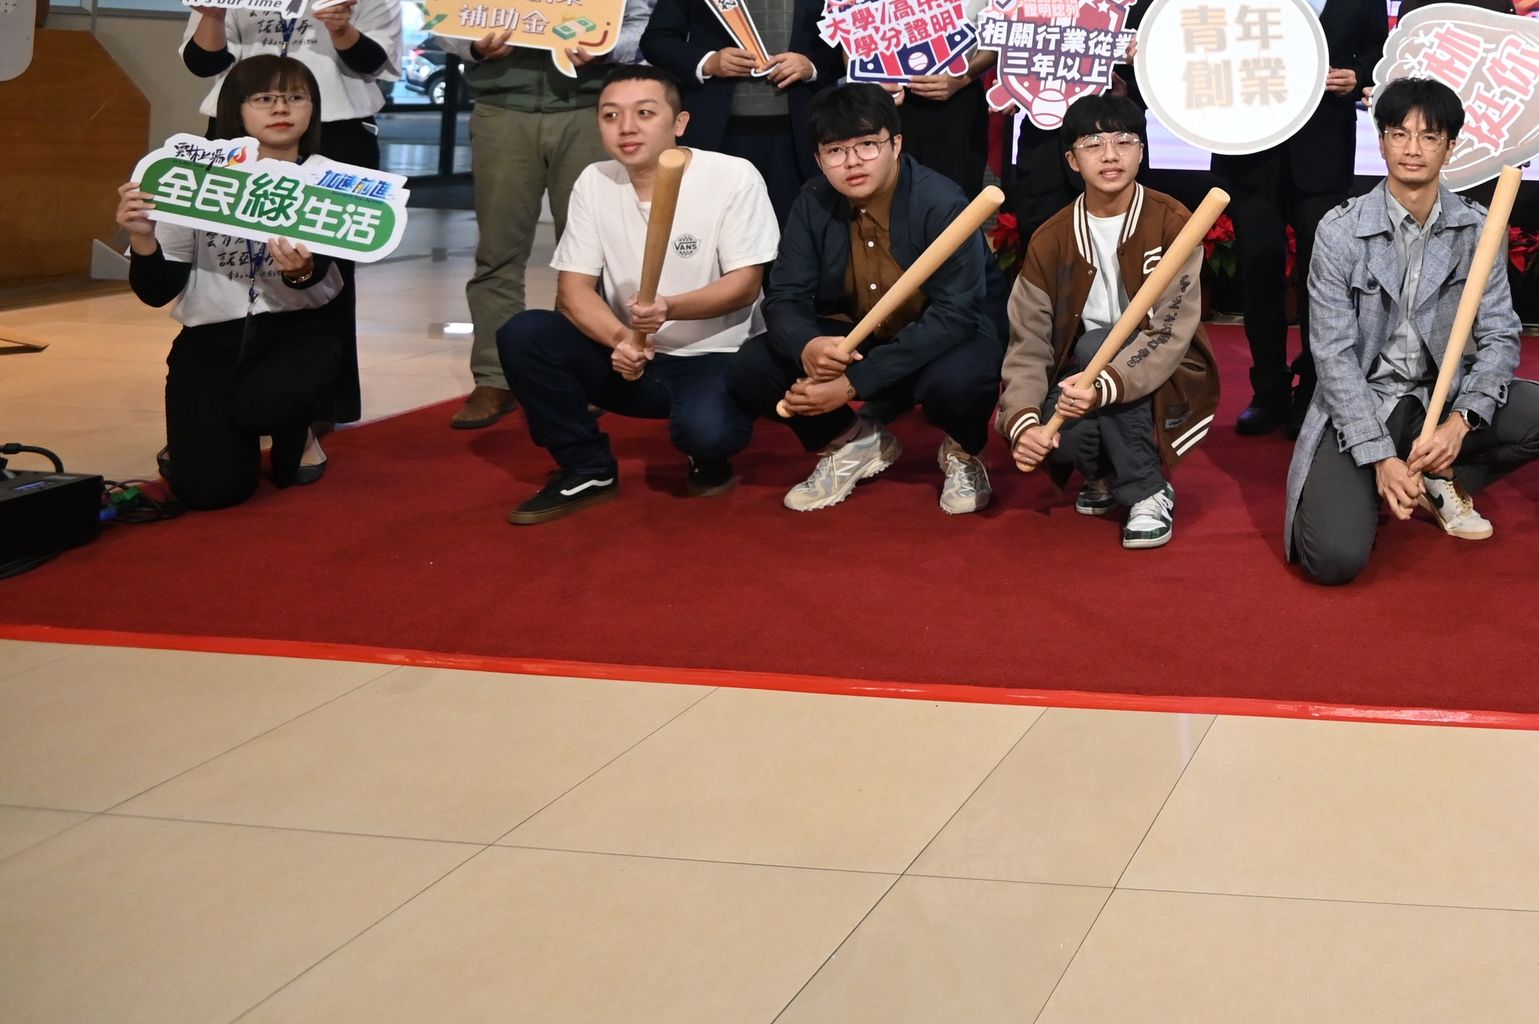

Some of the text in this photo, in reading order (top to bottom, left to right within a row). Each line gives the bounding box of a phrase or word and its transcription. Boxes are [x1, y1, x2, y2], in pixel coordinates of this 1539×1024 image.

[459, 4, 549, 35] 補助金
[1180, 3, 1283, 53] 青年
[1003, 51, 1107, 84] 三年以上
[1181, 57, 1288, 109] 創業
[153, 166, 382, 245] 全民綠生活
[674, 241, 697, 251] VANS
